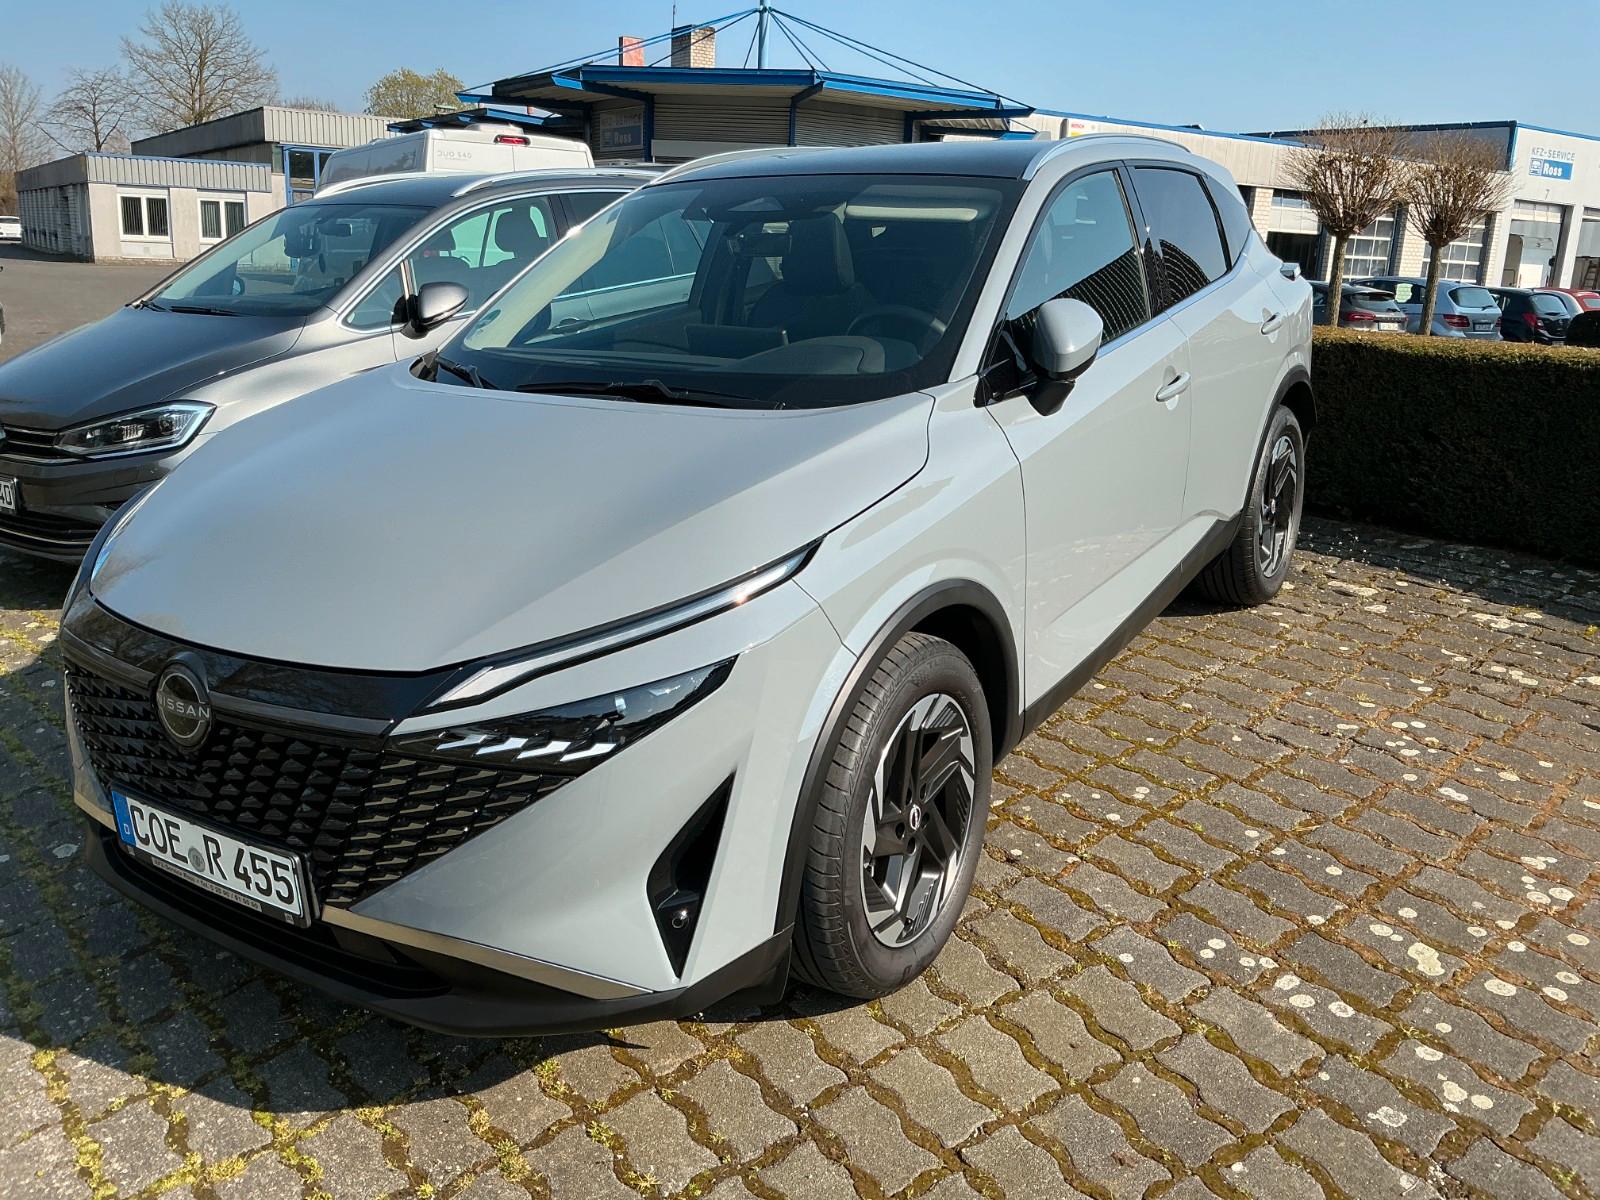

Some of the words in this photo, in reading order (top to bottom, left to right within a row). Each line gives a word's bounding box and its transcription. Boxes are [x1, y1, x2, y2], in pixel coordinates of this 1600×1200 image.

[1532, 147, 1575, 160] KFZ-SERVICE
[1543, 163, 1563, 177] Ross
[130, 805, 189, 864] COE
[203, 834, 228, 880] R
[233, 848, 295, 905] 455
